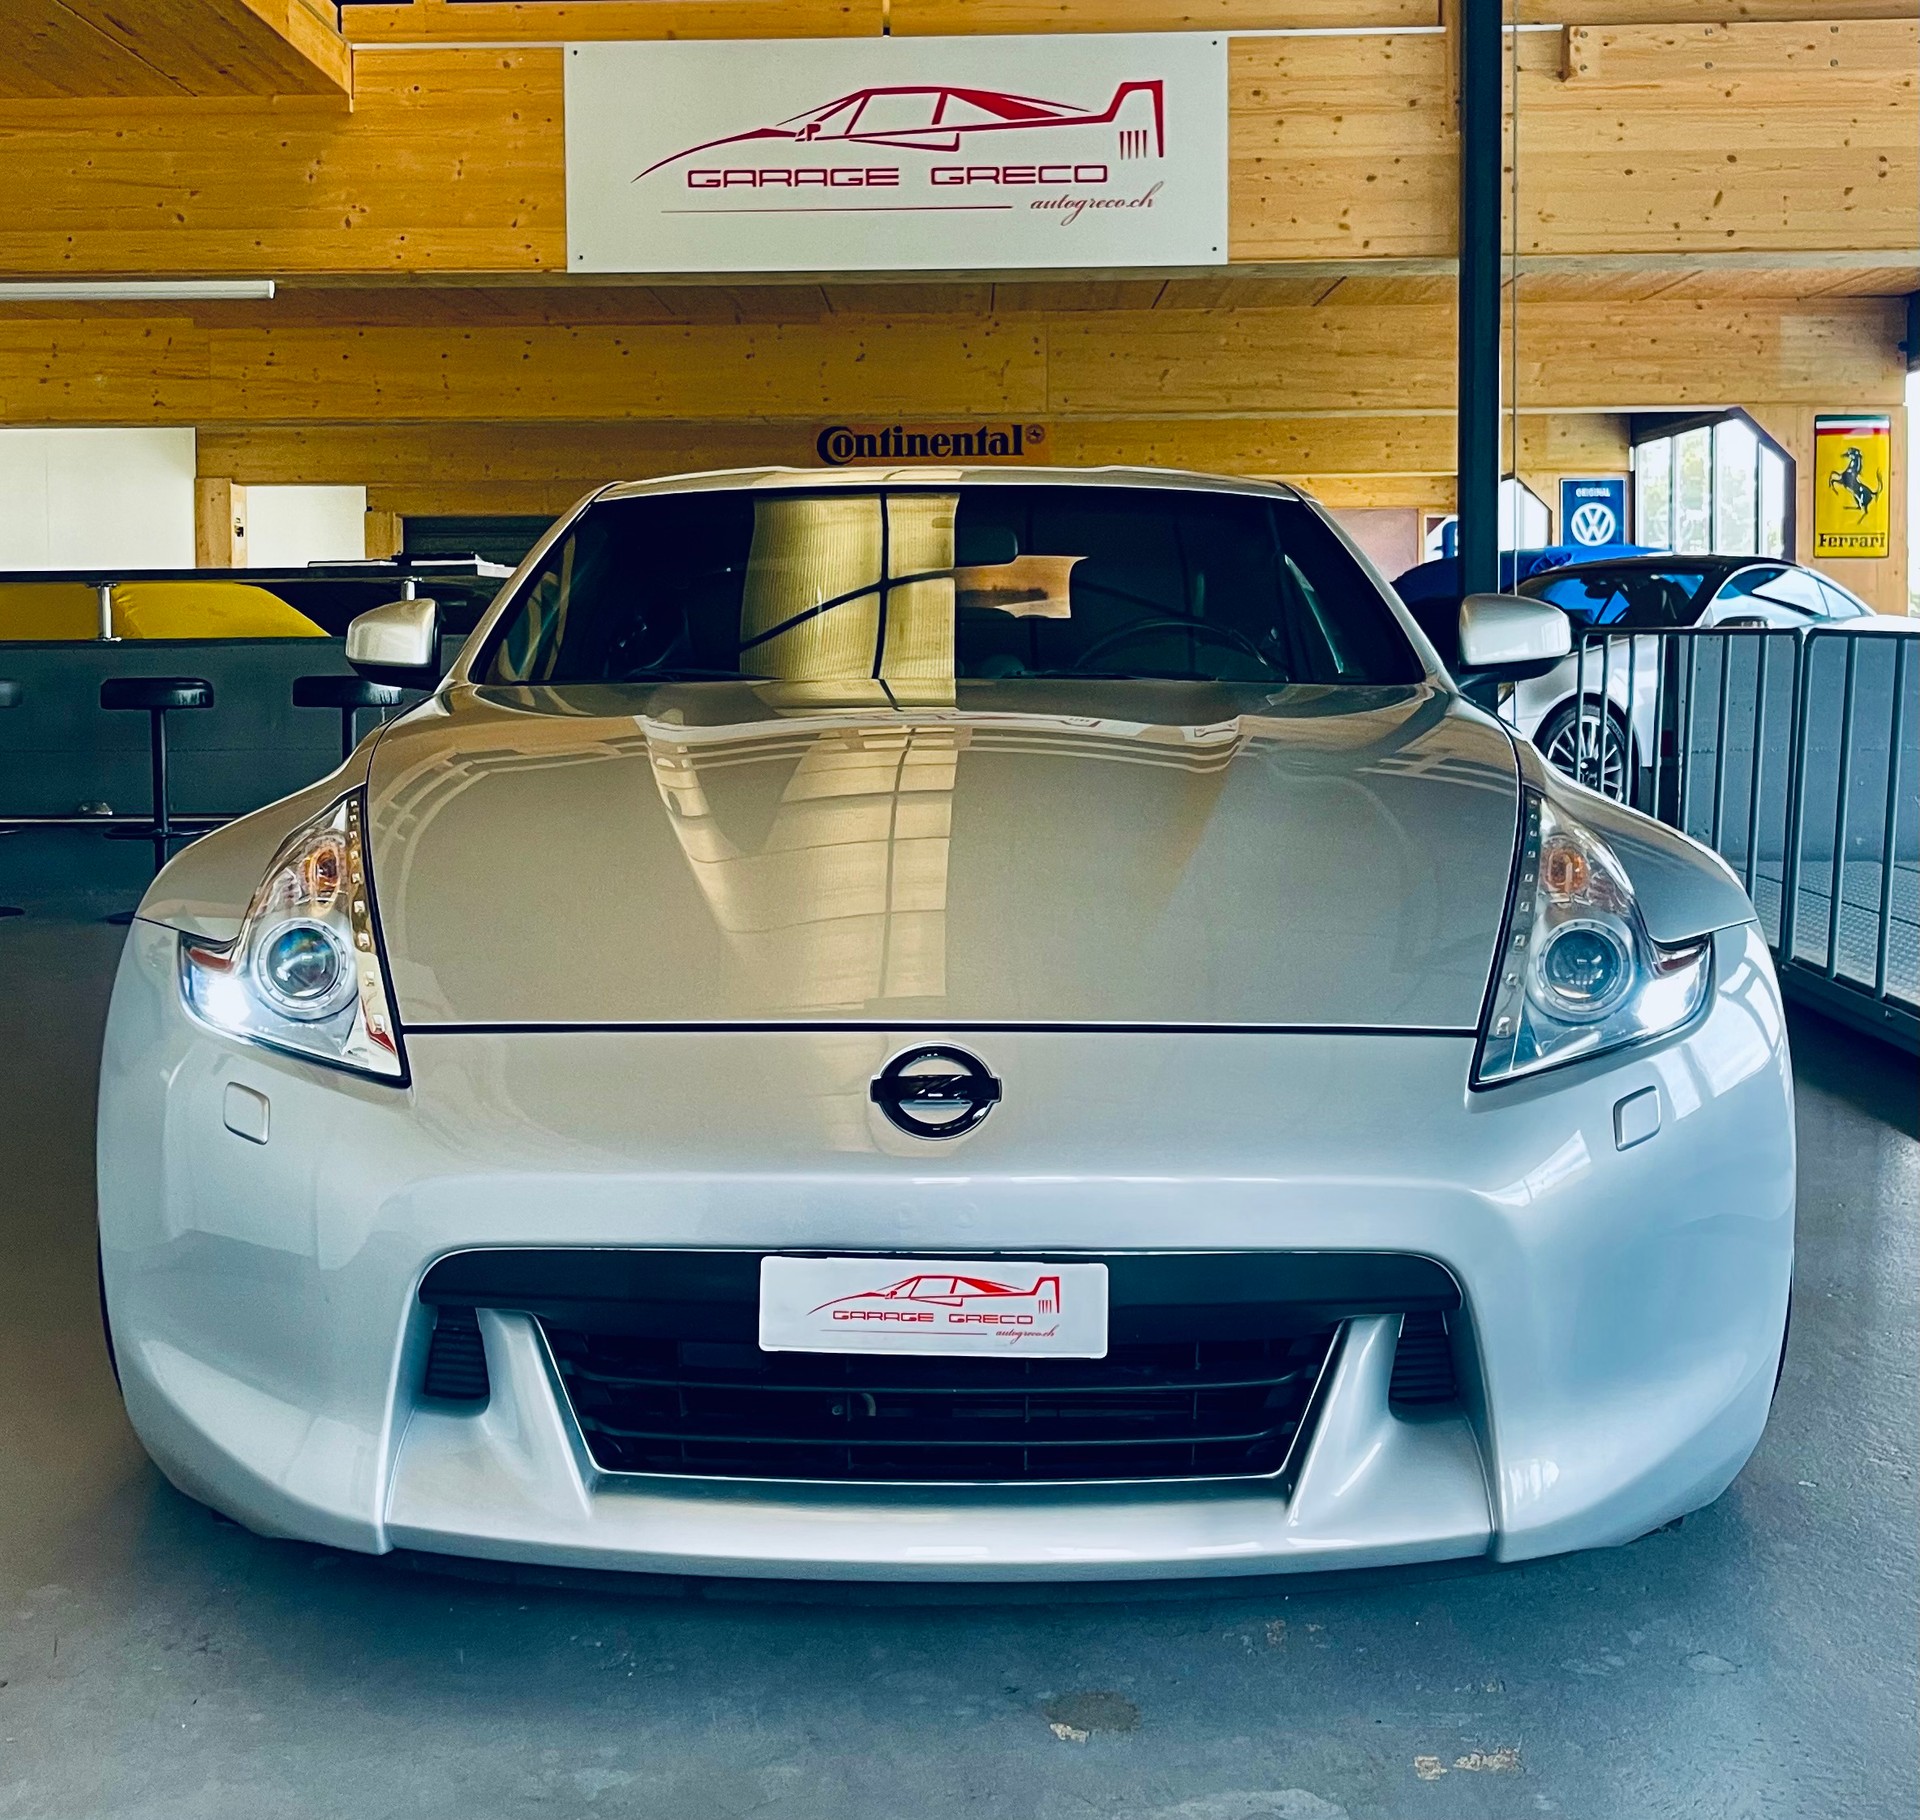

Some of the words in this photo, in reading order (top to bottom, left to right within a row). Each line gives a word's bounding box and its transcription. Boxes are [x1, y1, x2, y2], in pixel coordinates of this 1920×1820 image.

[687, 168, 899, 188] GARAGE
[930, 165, 1107, 185] GRECO
[1030, 180, 1164, 226] autogreco.ch
[816, 424, 1024, 466] Continental
[1817, 532, 1886, 548] Ferrari
[832, 1310, 935, 1323] GARAGE
[948, 1313, 1034, 1325] GRECO
